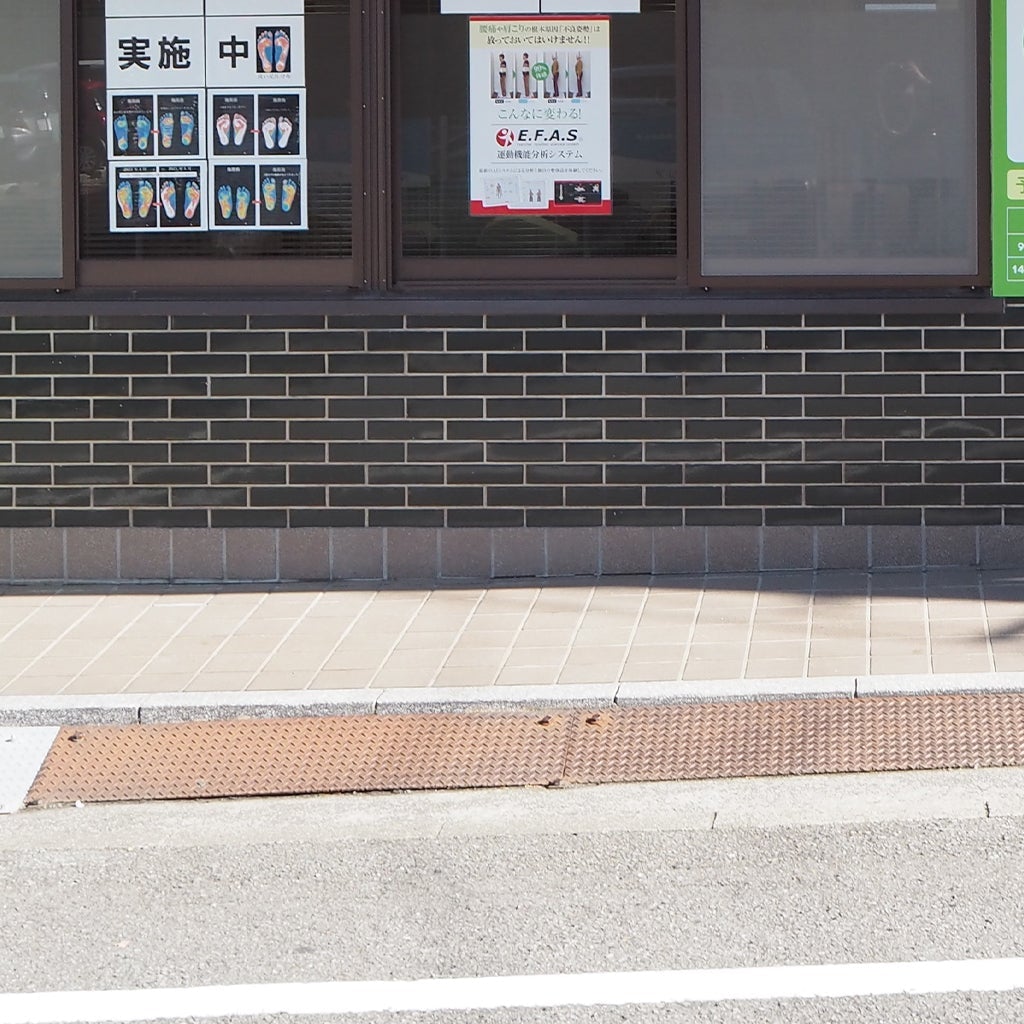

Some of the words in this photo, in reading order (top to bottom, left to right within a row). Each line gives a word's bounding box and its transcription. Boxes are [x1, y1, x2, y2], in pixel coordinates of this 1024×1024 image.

[118, 36, 191, 70] 実施
[219, 35, 249, 68] 中
[517, 129, 579, 142] E.F.A.S
